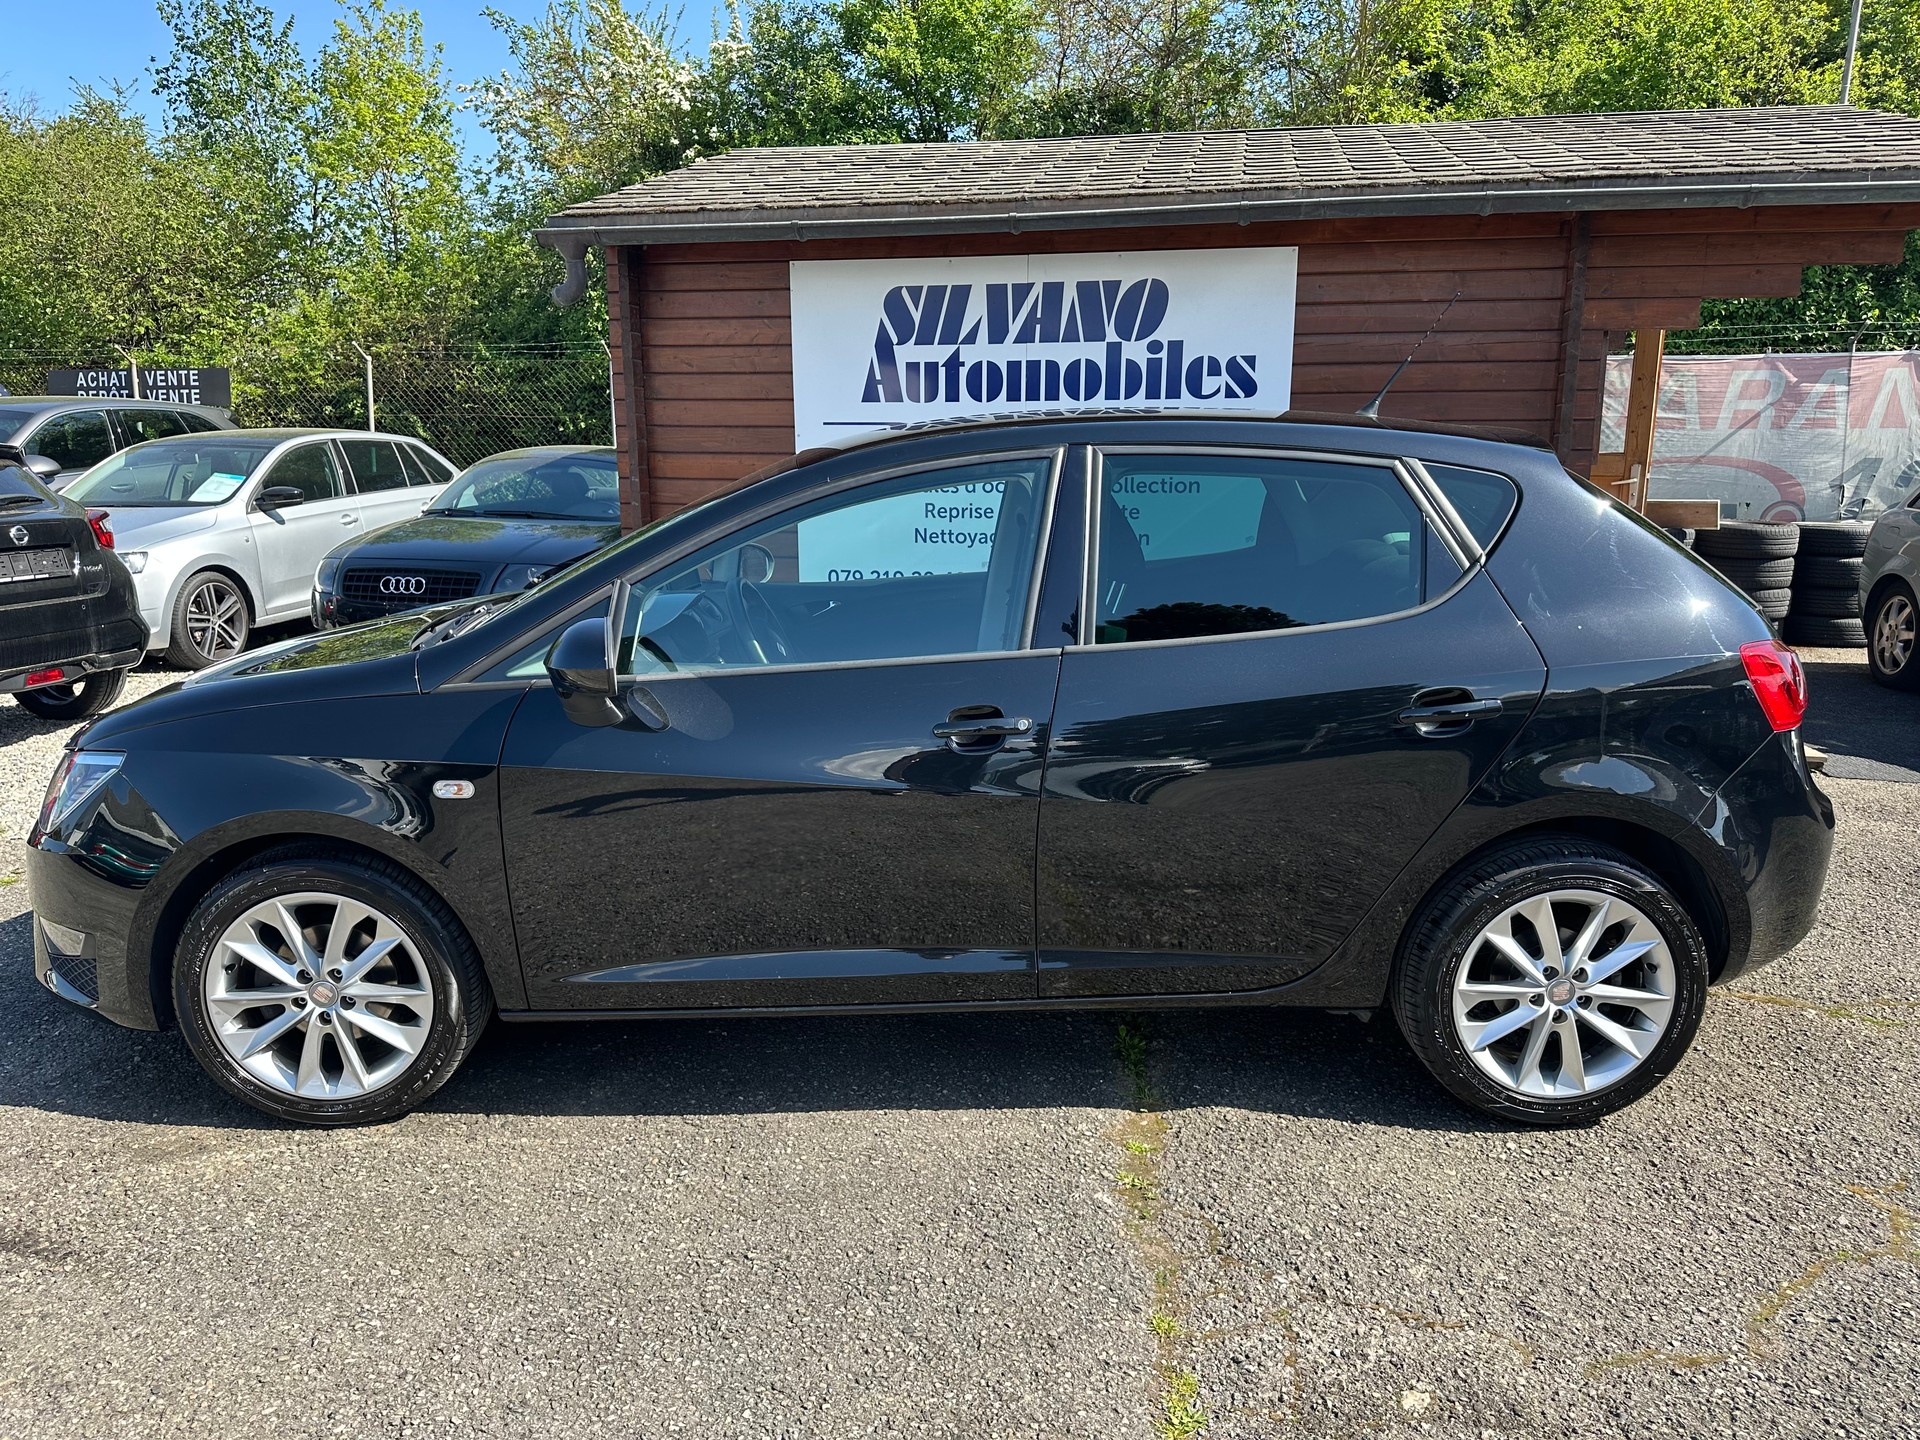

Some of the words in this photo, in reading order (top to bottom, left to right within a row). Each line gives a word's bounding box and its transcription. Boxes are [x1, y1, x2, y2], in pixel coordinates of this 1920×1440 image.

[883, 278, 1169, 346] SILVANO
[861, 317, 1258, 403] Automobiles
[76, 371, 127, 387] ACHAT
[144, 370, 199, 386] VENTE
[146, 389, 201, 404] VENTE
[1111, 476, 1200, 494] ollection
[924, 502, 994, 522] Reprise
